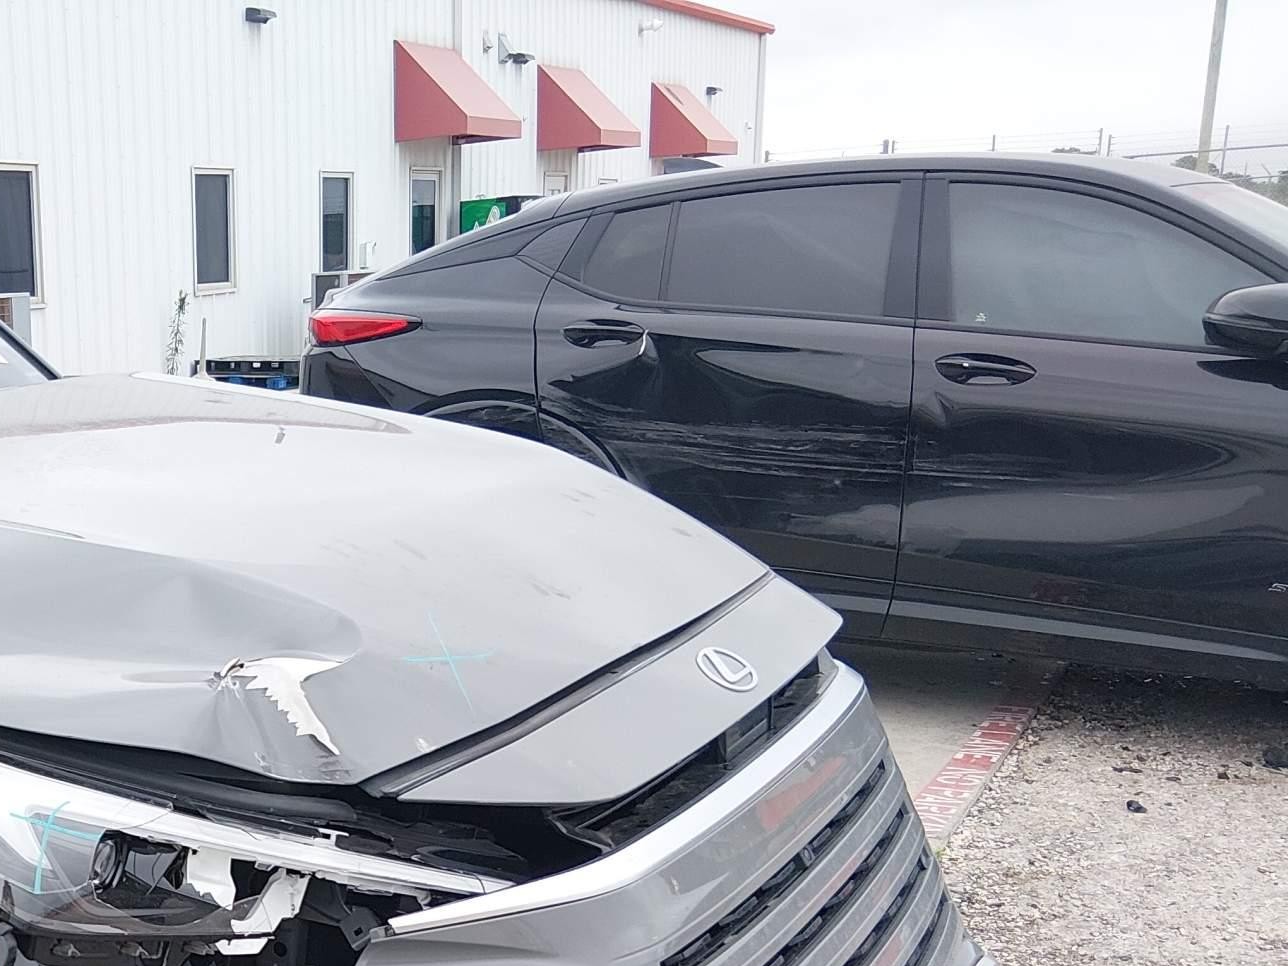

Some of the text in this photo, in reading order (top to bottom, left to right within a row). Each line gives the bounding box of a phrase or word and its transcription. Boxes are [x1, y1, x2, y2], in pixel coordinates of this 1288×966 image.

[979, 705, 1032, 731] FIRE
[953, 729, 1017, 763] LANE
[936, 765, 989, 786] NO
